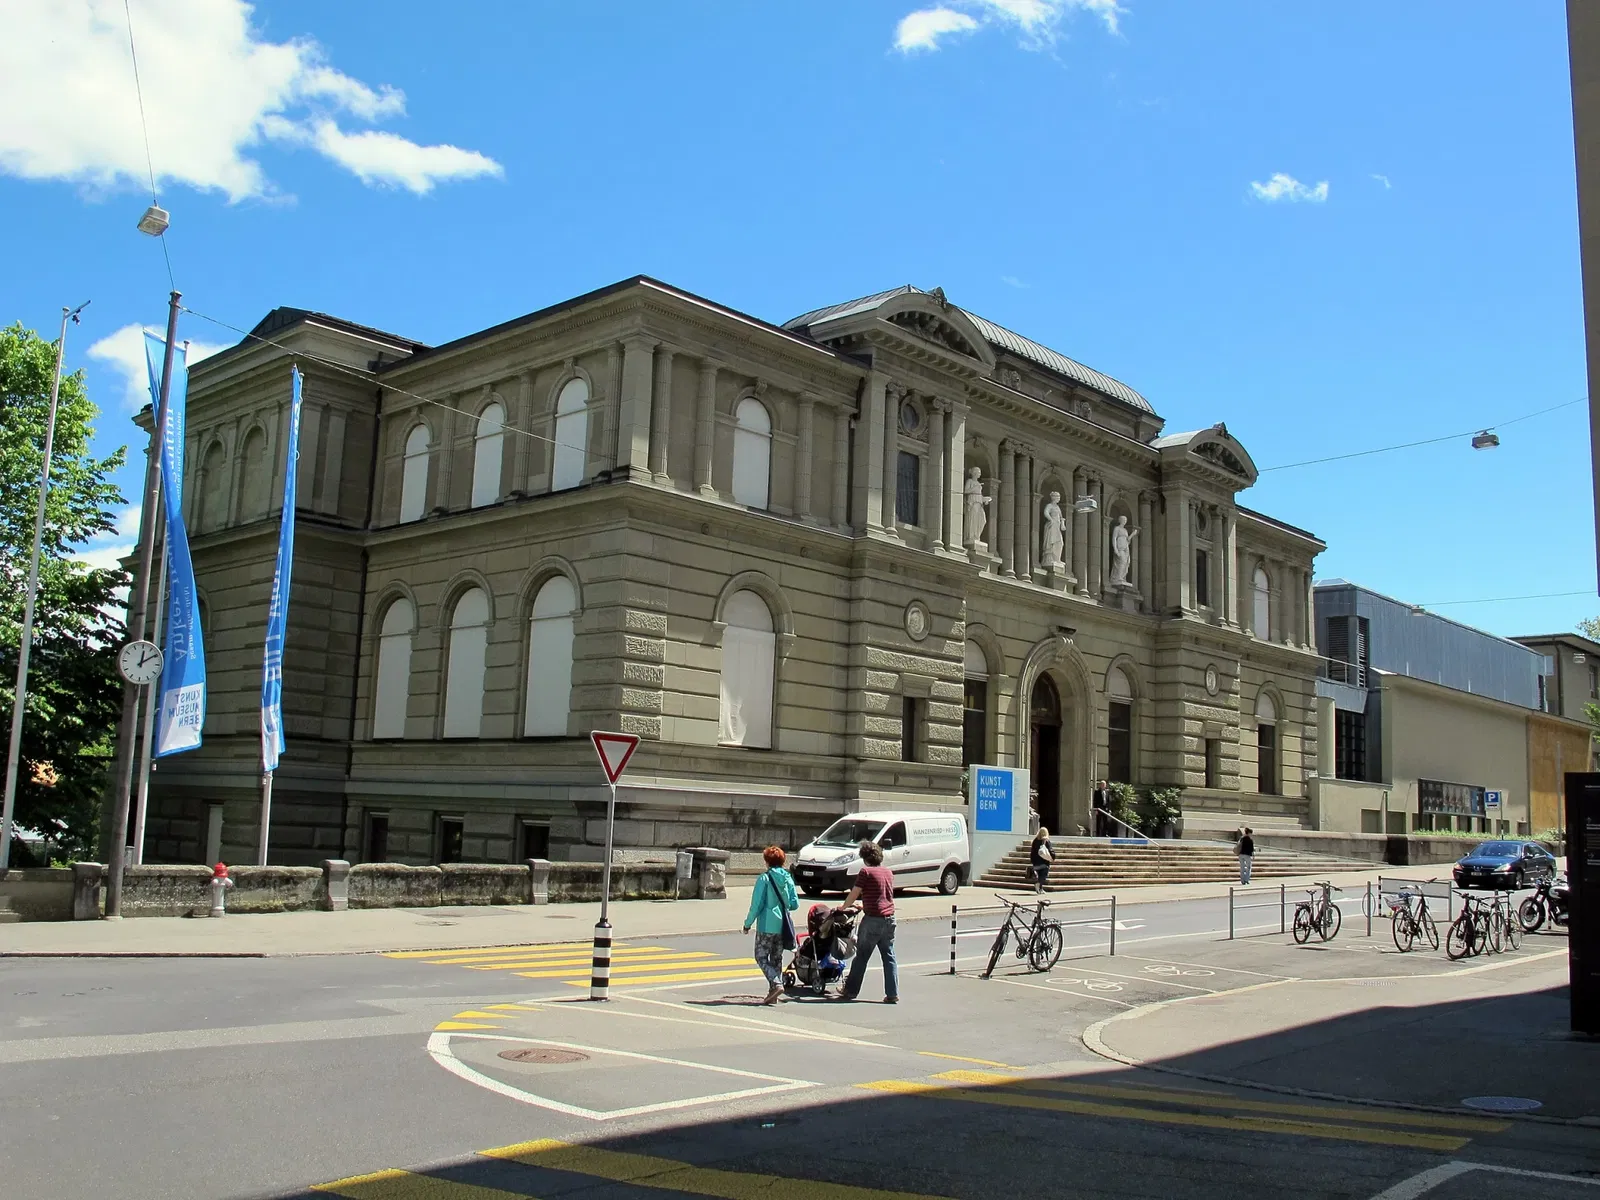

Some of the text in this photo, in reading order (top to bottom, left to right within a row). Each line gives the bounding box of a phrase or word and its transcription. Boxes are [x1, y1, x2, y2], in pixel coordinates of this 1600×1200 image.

[980, 775, 1002, 787] KUNST
[980, 788, 1006, 799] MUSEUM
[1488, 793, 1496, 802] P
[980, 799, 998, 810] BERN
